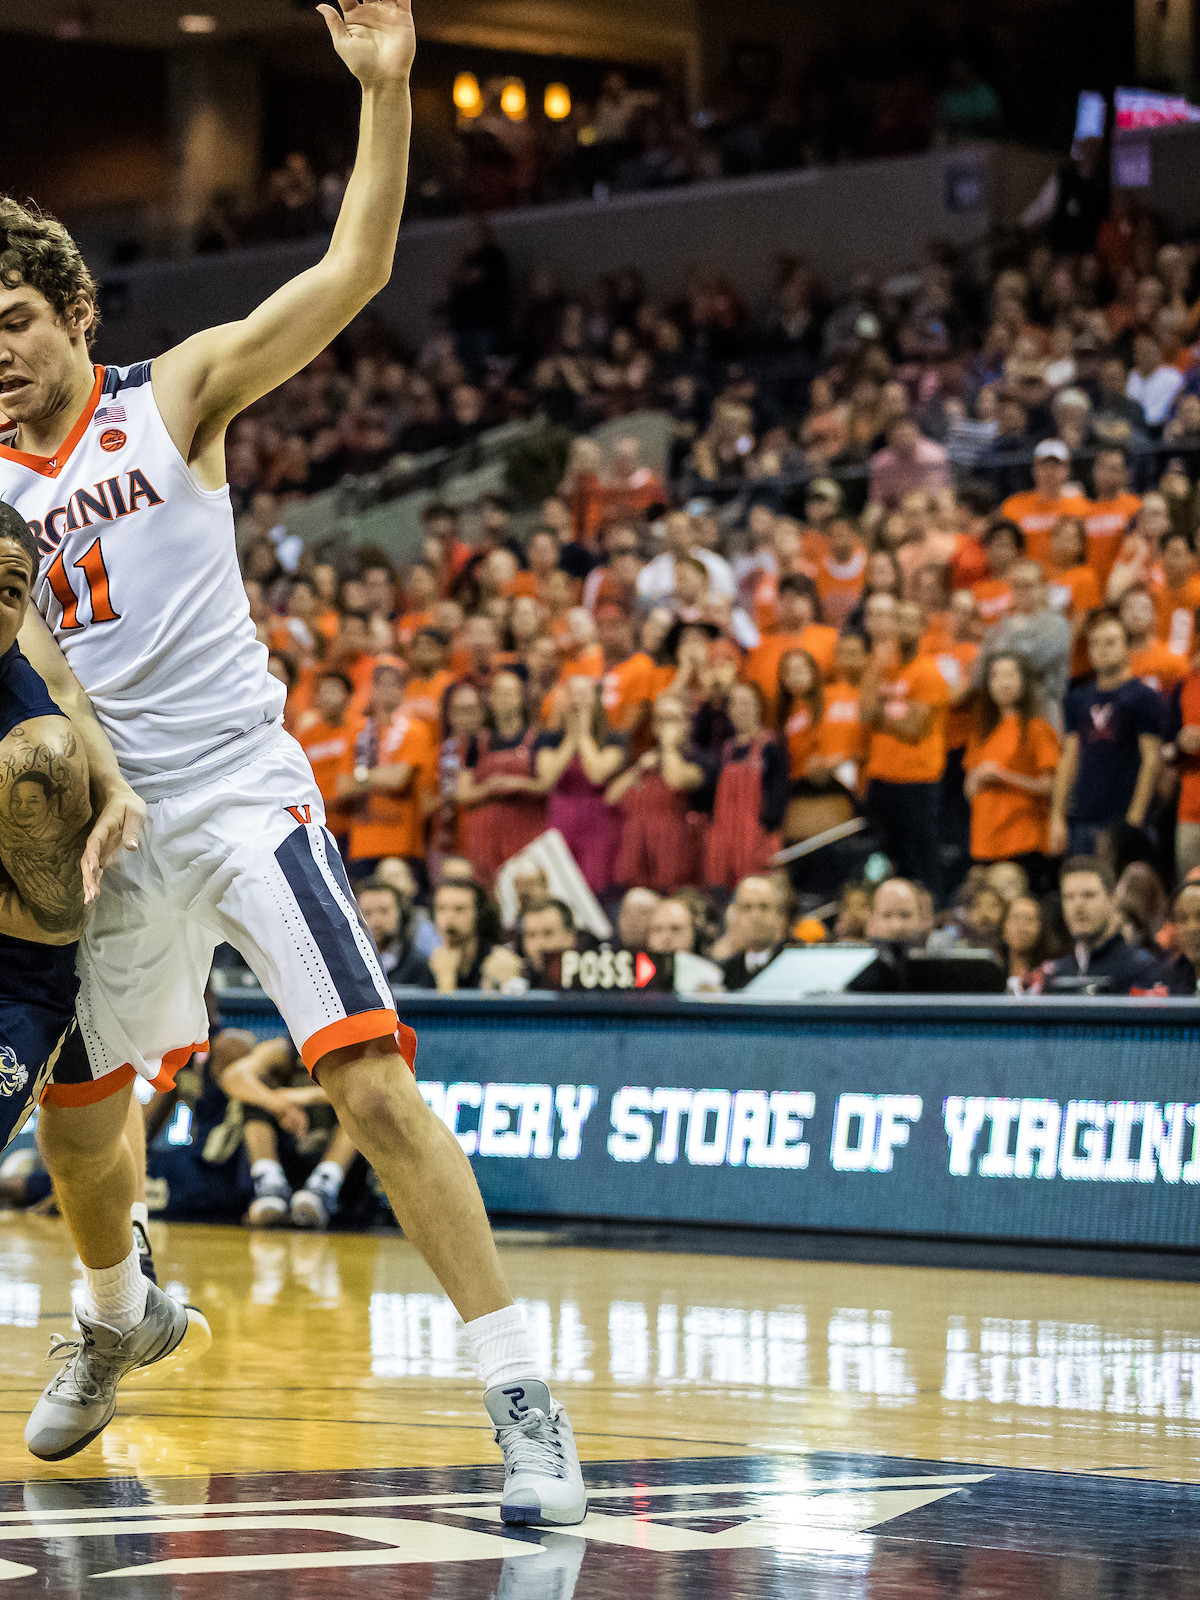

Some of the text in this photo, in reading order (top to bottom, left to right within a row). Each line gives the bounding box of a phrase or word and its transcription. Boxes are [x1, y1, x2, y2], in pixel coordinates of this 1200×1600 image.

[26, 468, 165, 558] RGINIA
[45, 536, 122, 630] 11
[282, 804, 311, 824] V
[607, 1086, 816, 1170] STORE
[830, 1092, 923, 1173] OF
